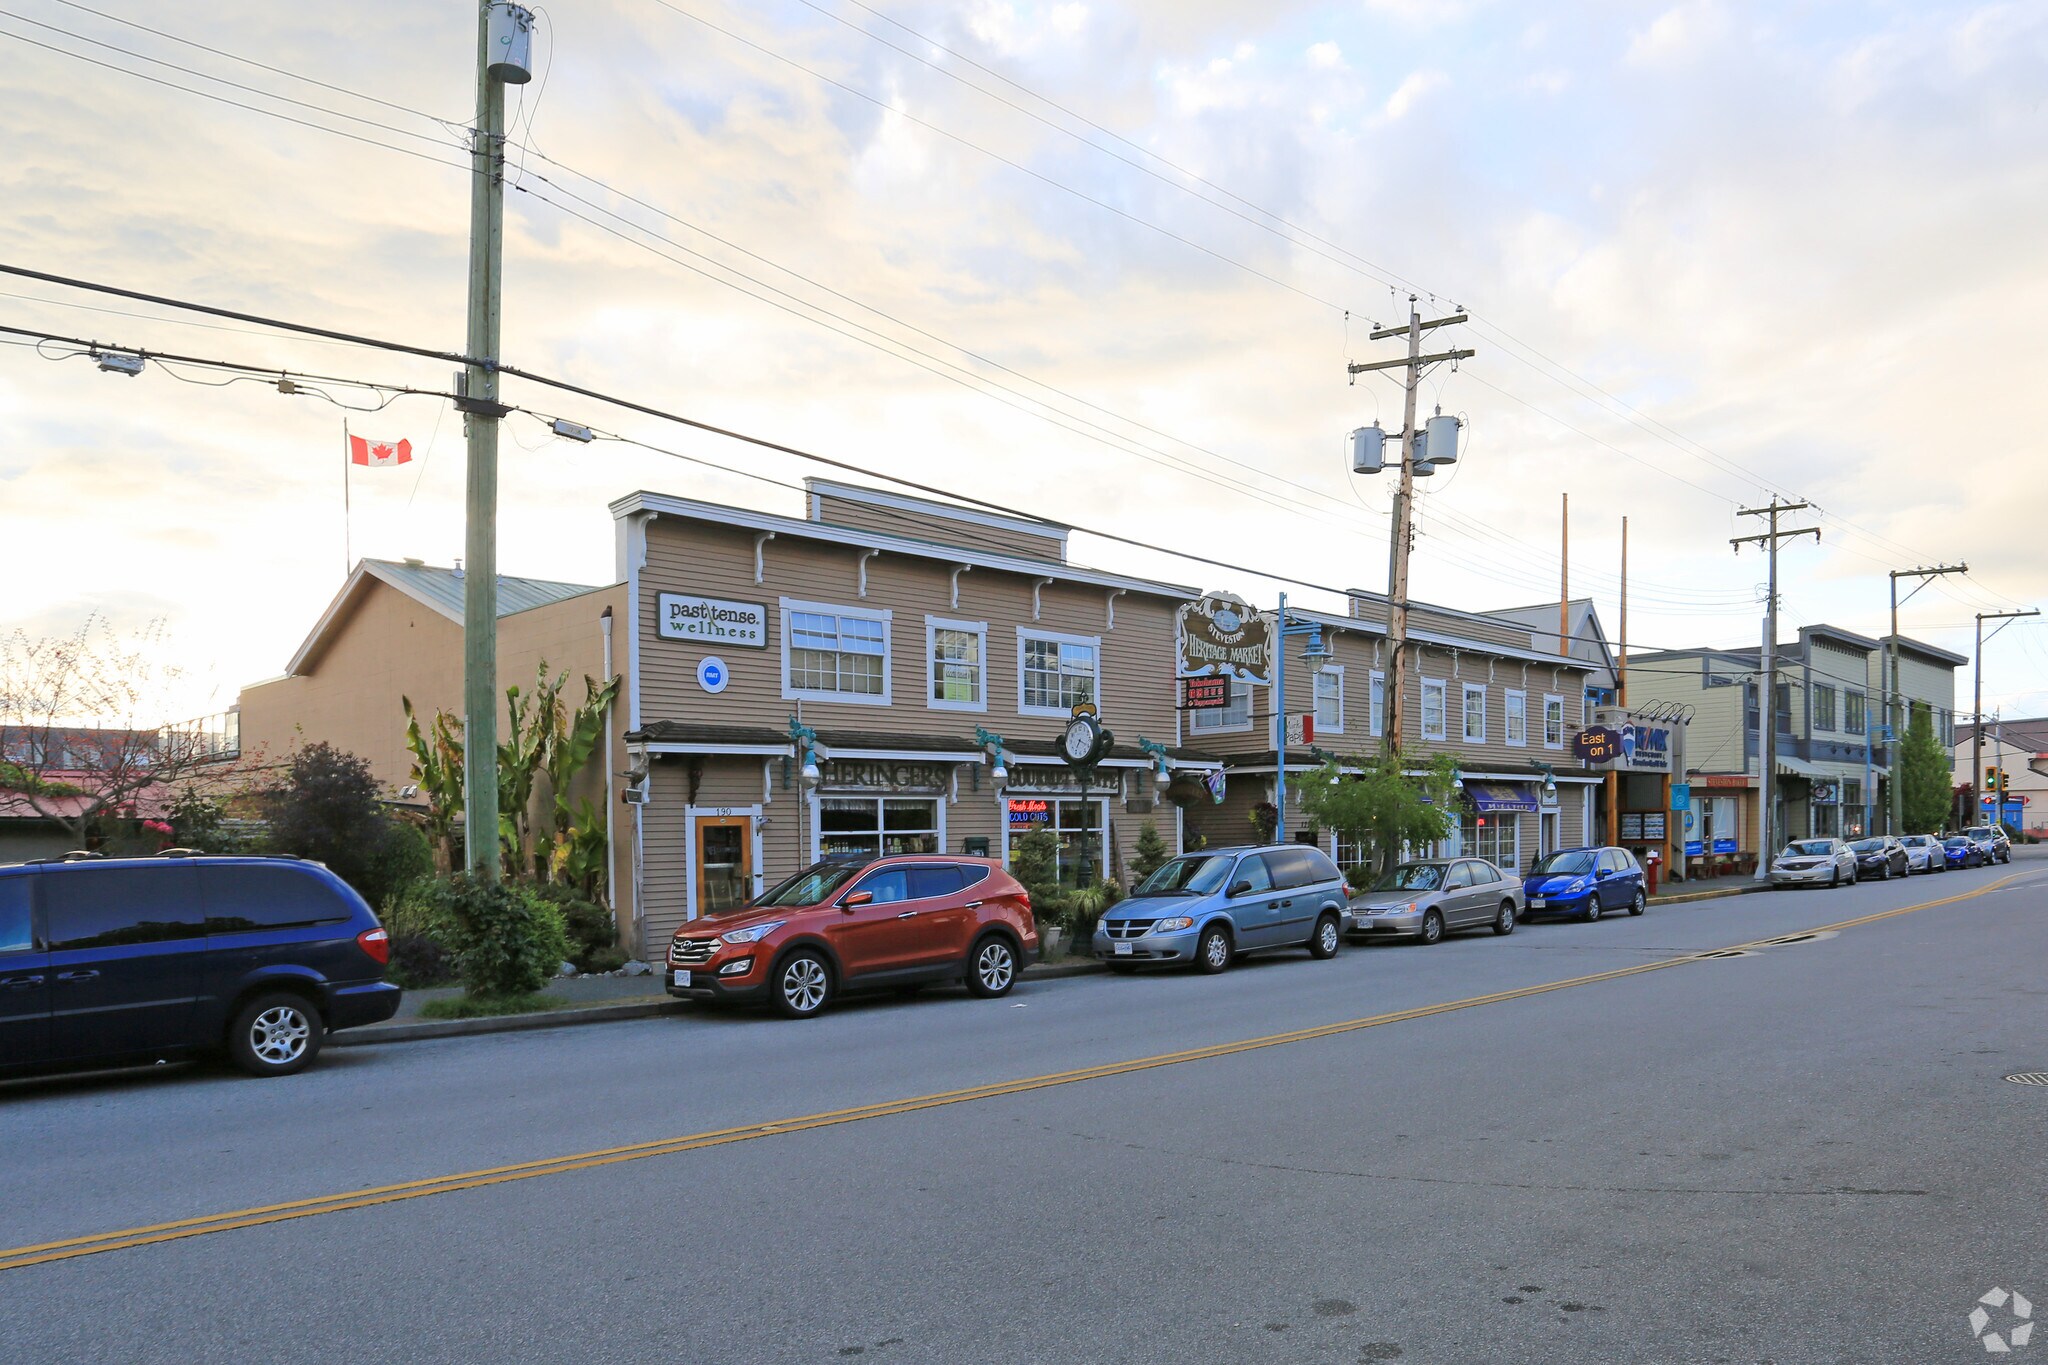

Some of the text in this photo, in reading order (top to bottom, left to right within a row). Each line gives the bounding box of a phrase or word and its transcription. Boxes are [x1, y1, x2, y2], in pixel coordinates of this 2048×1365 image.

[669, 603, 708, 619] past
[669, 621, 756, 639] wellness
[1207, 623, 1246, 644] STEVESTON
[1188, 633, 1264, 667] HERITAGE MARKET
[1581, 733, 1606, 745] East
[1634, 726, 1669, 752] RE/MAX
[1590, 743, 1613, 756] on 1
[821, 762, 947, 787] HERINGERS
[716, 808, 732, 816] 190
[1008, 799, 1048, 812] Fresh Meats
[1009, 812, 1049, 822] COLD CUTS
